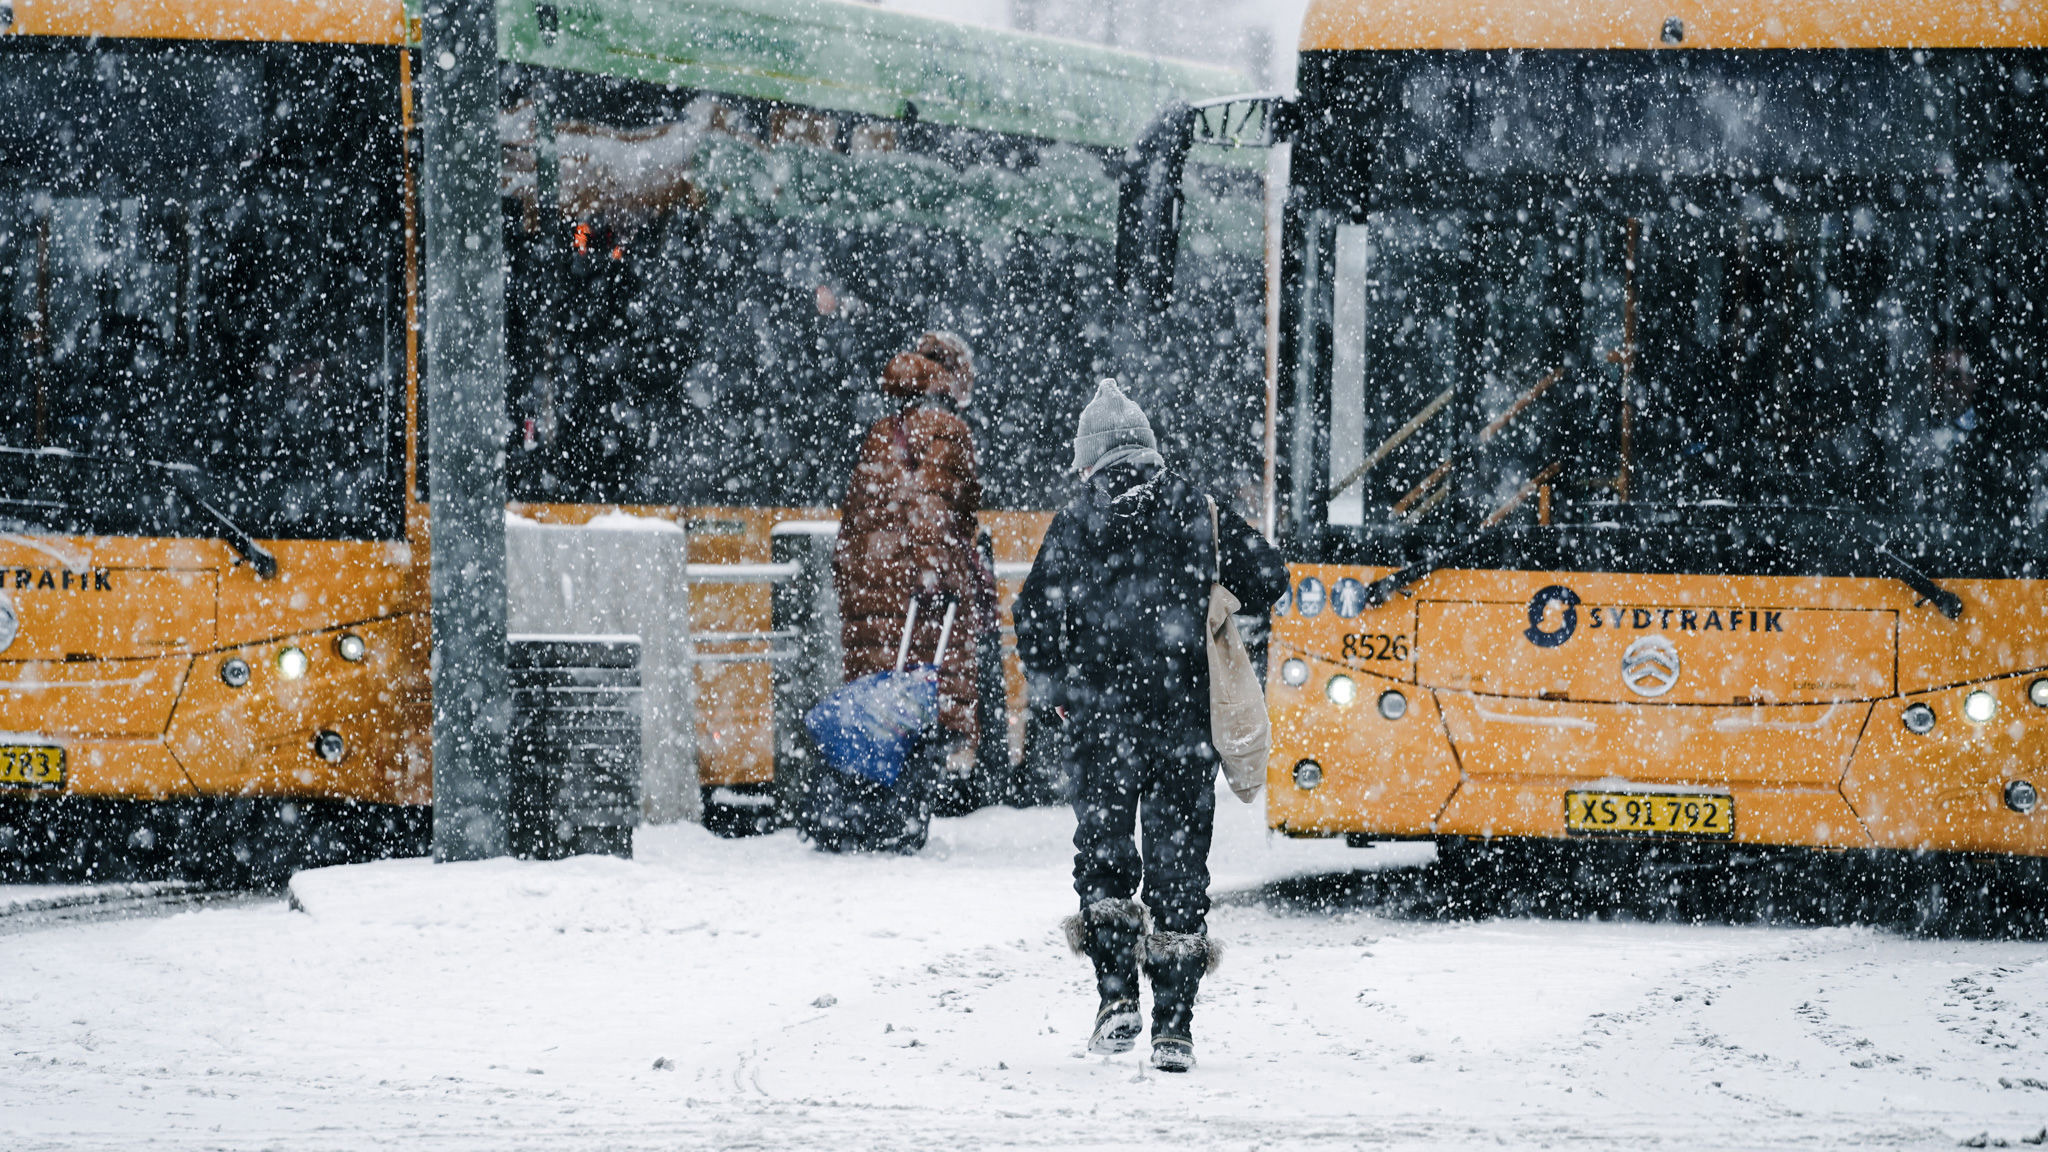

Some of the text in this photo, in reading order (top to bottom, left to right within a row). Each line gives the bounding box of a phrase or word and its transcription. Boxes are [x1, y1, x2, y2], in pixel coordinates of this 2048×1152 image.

[1589, 608, 1783, 632] SYDTRAFIK
[1342, 633, 1408, 660] 8526
[3, 752, 49, 776] 783
[1582, 800, 1717, 827] XS 91 792
